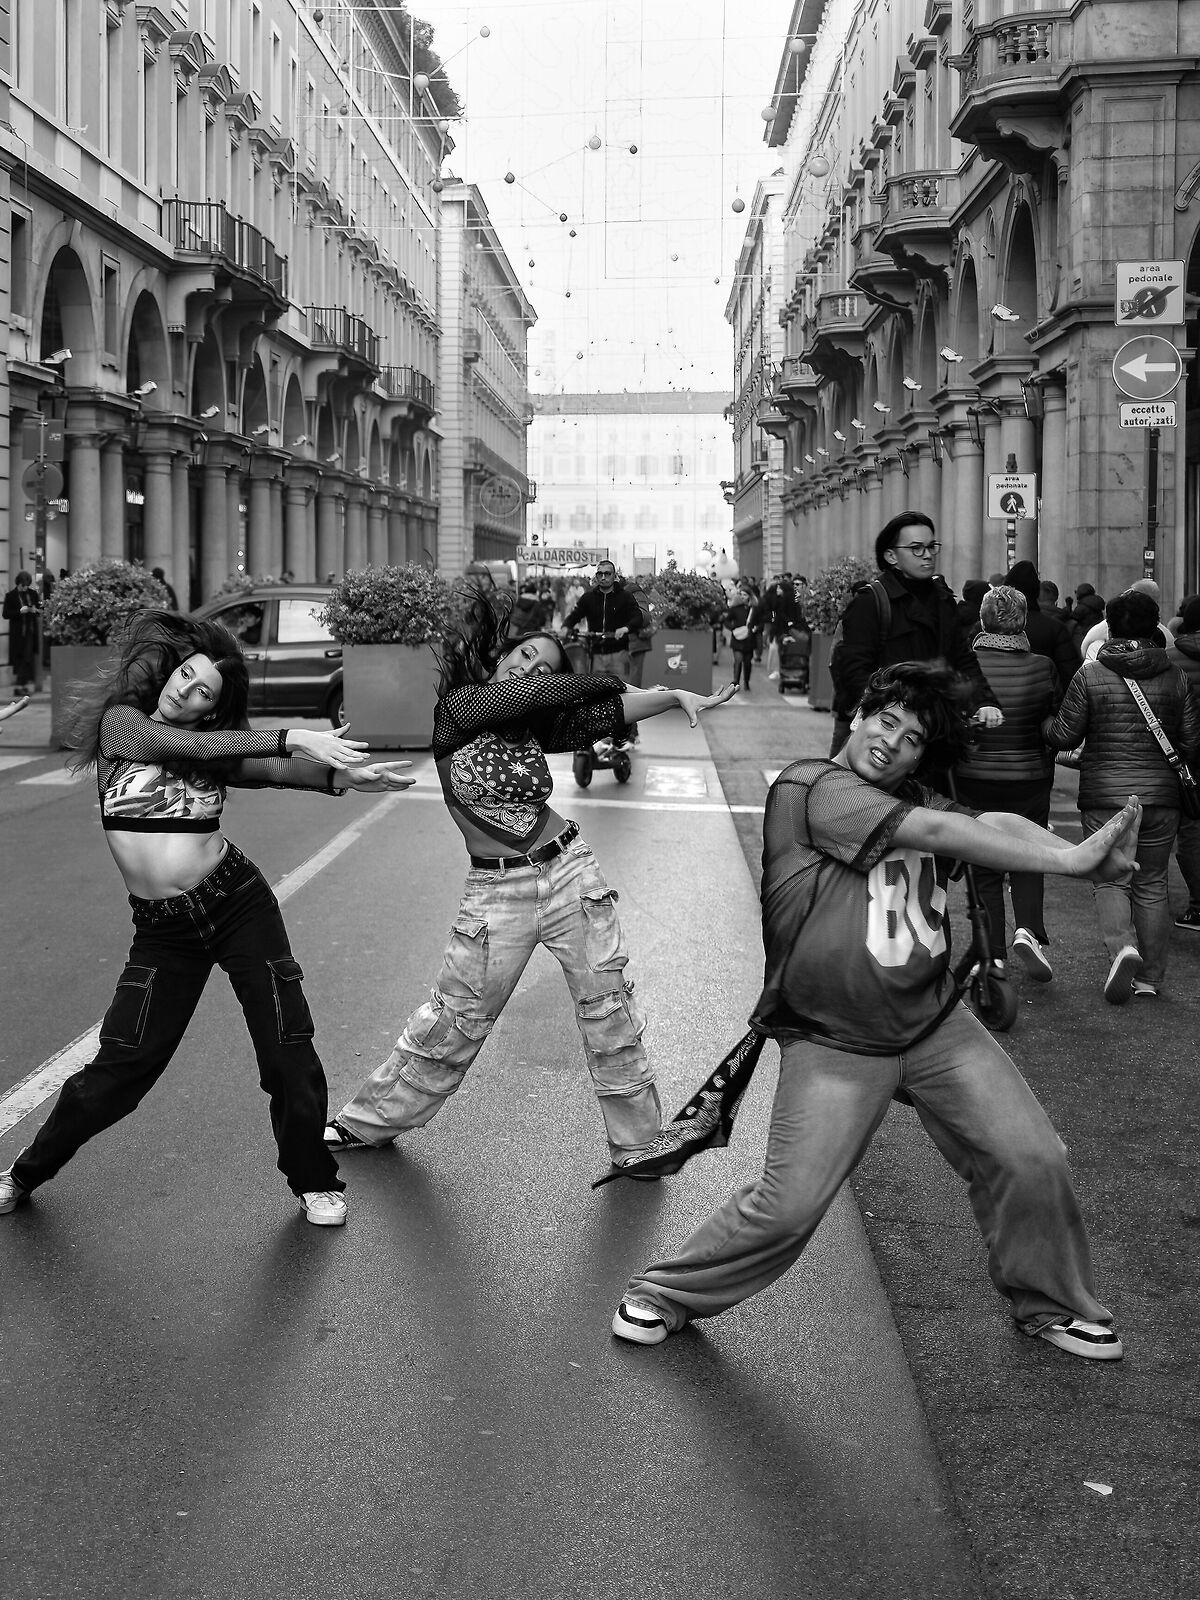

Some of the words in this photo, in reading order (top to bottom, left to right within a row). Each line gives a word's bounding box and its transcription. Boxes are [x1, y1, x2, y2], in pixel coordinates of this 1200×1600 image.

[1128, 274, 1173, 284] pedonale
[1131, 404, 1166, 414] eccetto
[1124, 415, 1174, 427] autorizati
